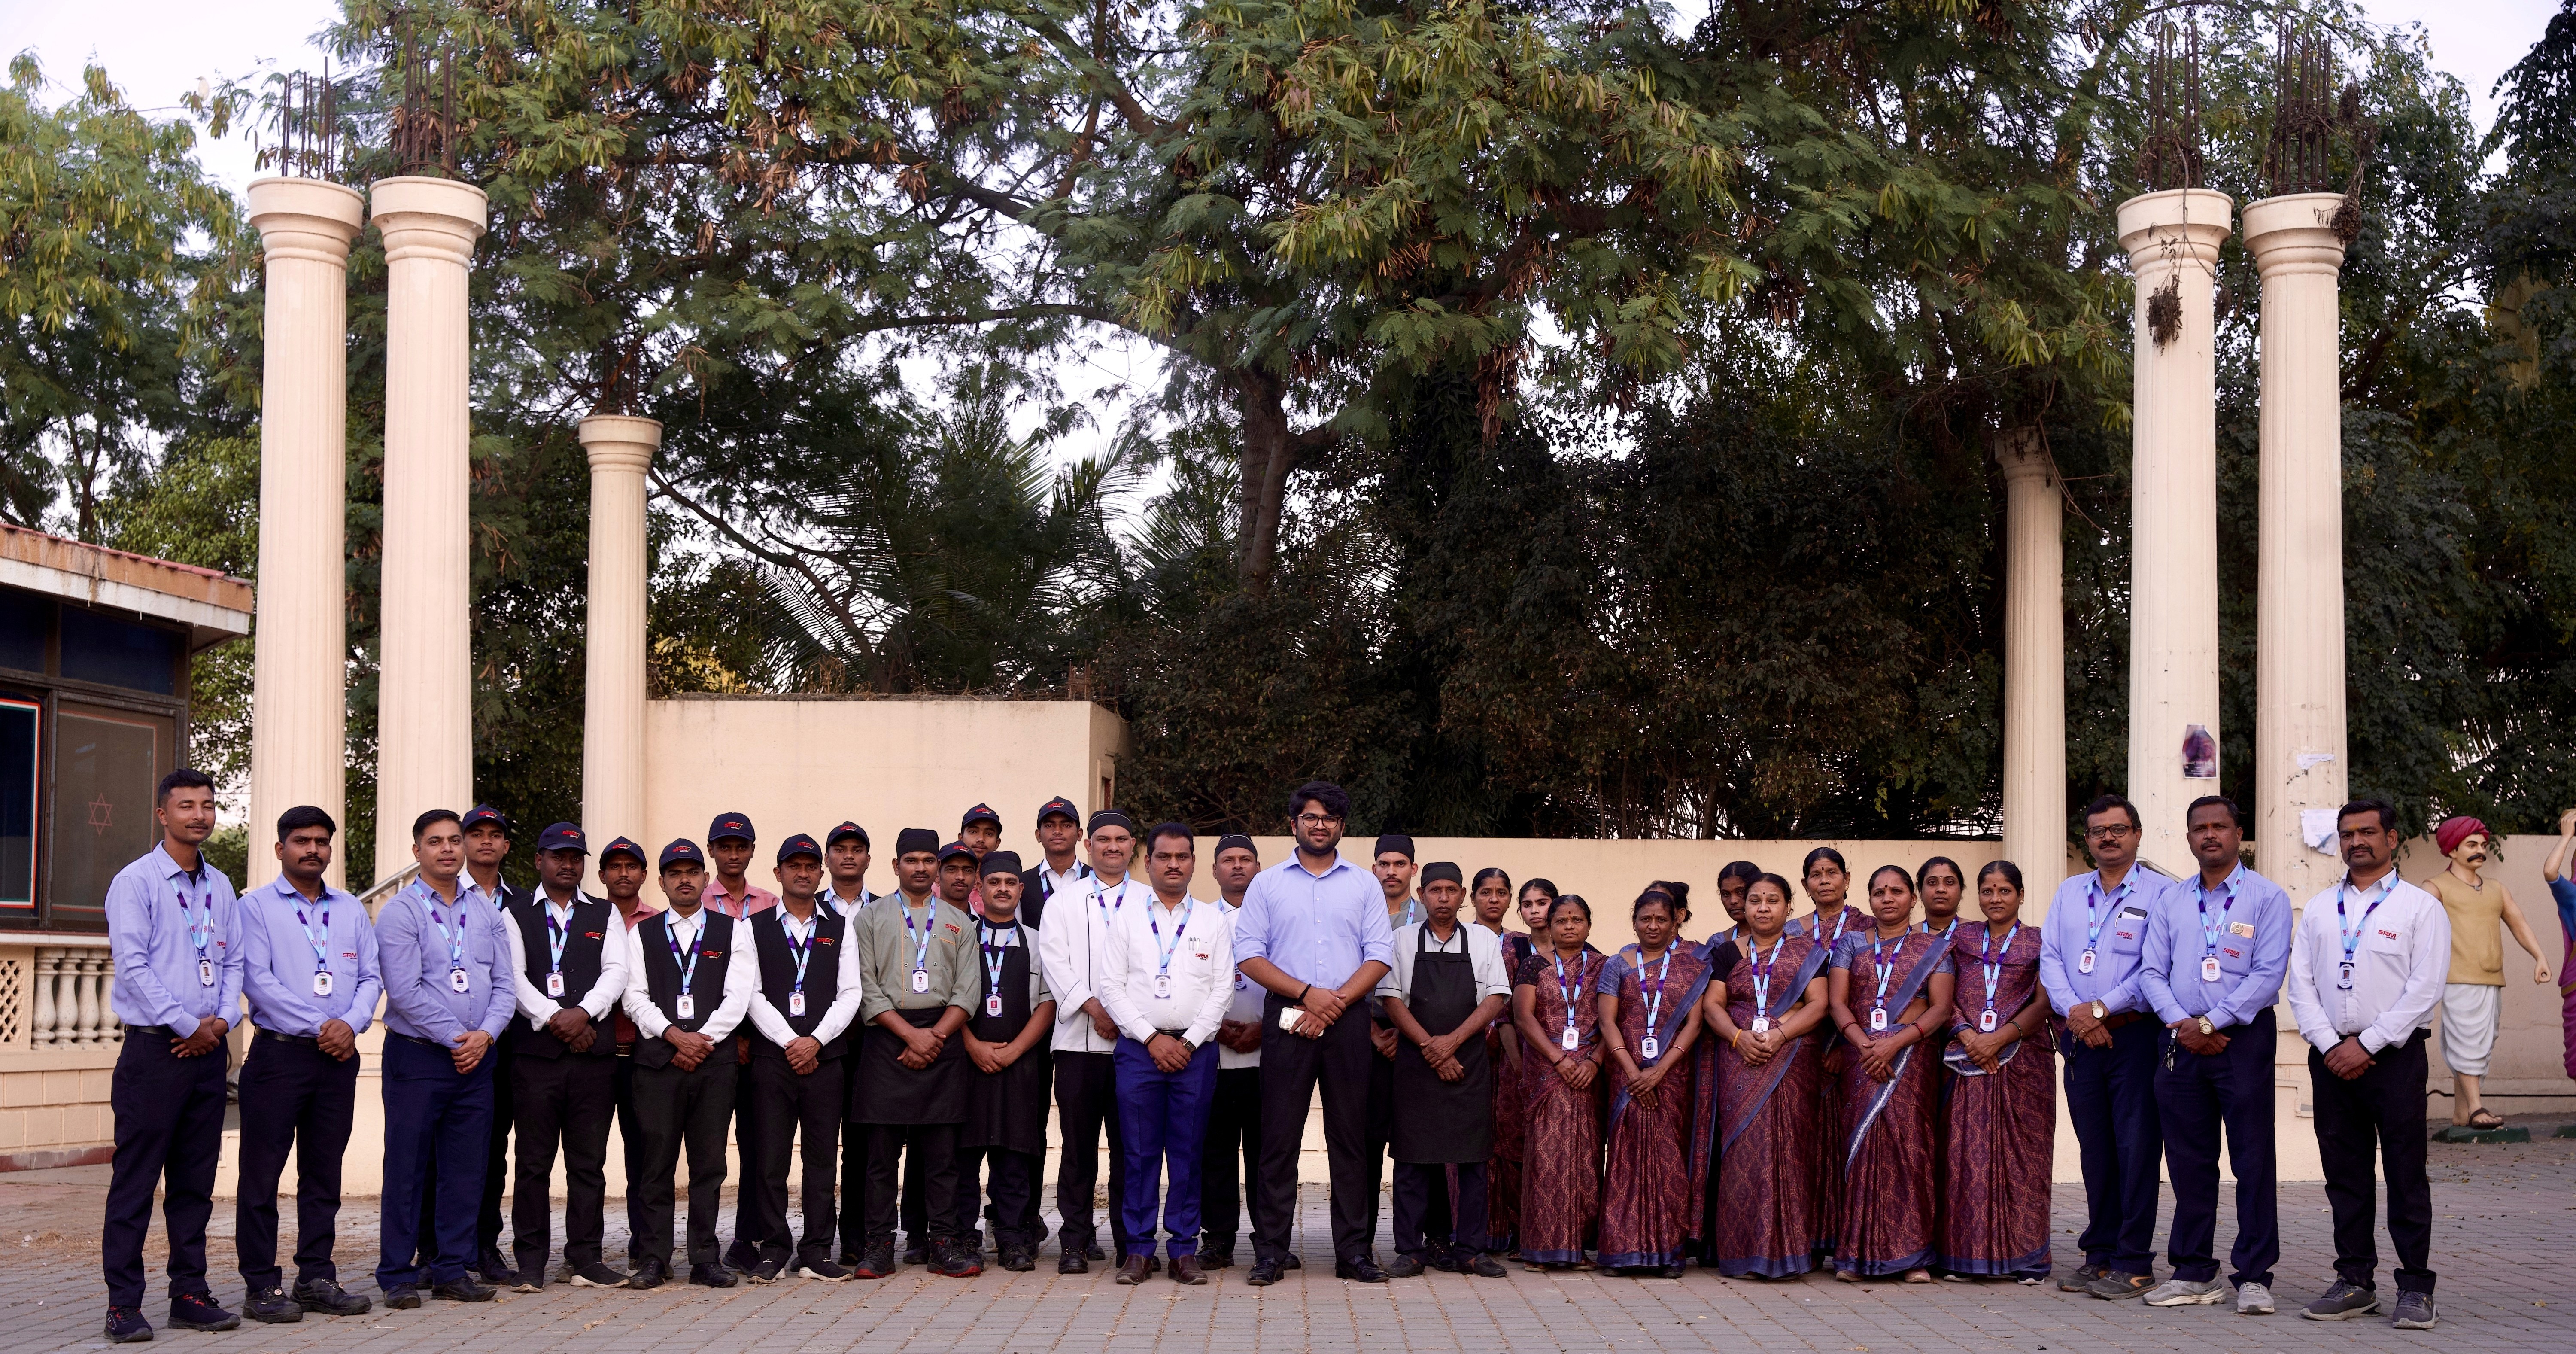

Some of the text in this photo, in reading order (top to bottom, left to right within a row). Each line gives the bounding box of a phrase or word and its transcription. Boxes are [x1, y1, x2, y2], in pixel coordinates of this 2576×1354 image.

[945, 924, 960, 933] SRM
[2378, 929, 2397, 939] SRM
[2223, 948, 2240, 956] SRM
